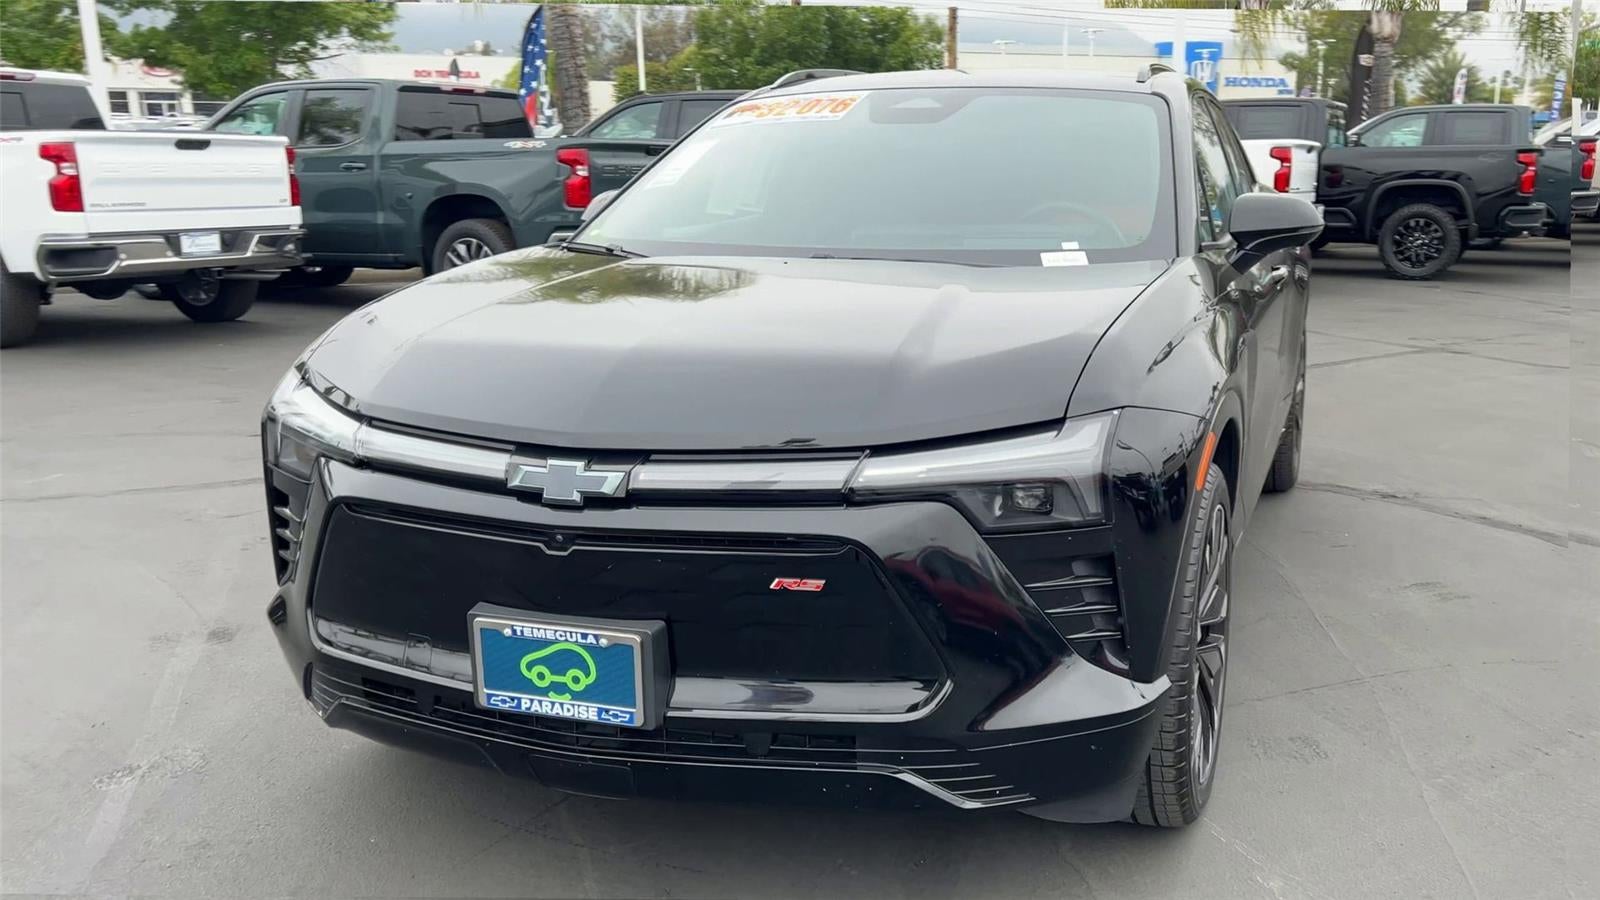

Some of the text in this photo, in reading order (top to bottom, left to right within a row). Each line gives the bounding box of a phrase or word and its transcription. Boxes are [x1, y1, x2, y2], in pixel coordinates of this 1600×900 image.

[1224, 76, 1289, 88] HONDA
[769, 577, 826, 592] RS
[512, 625, 598, 645] TEMECULA
[521, 698, 599, 720] PARADISE
